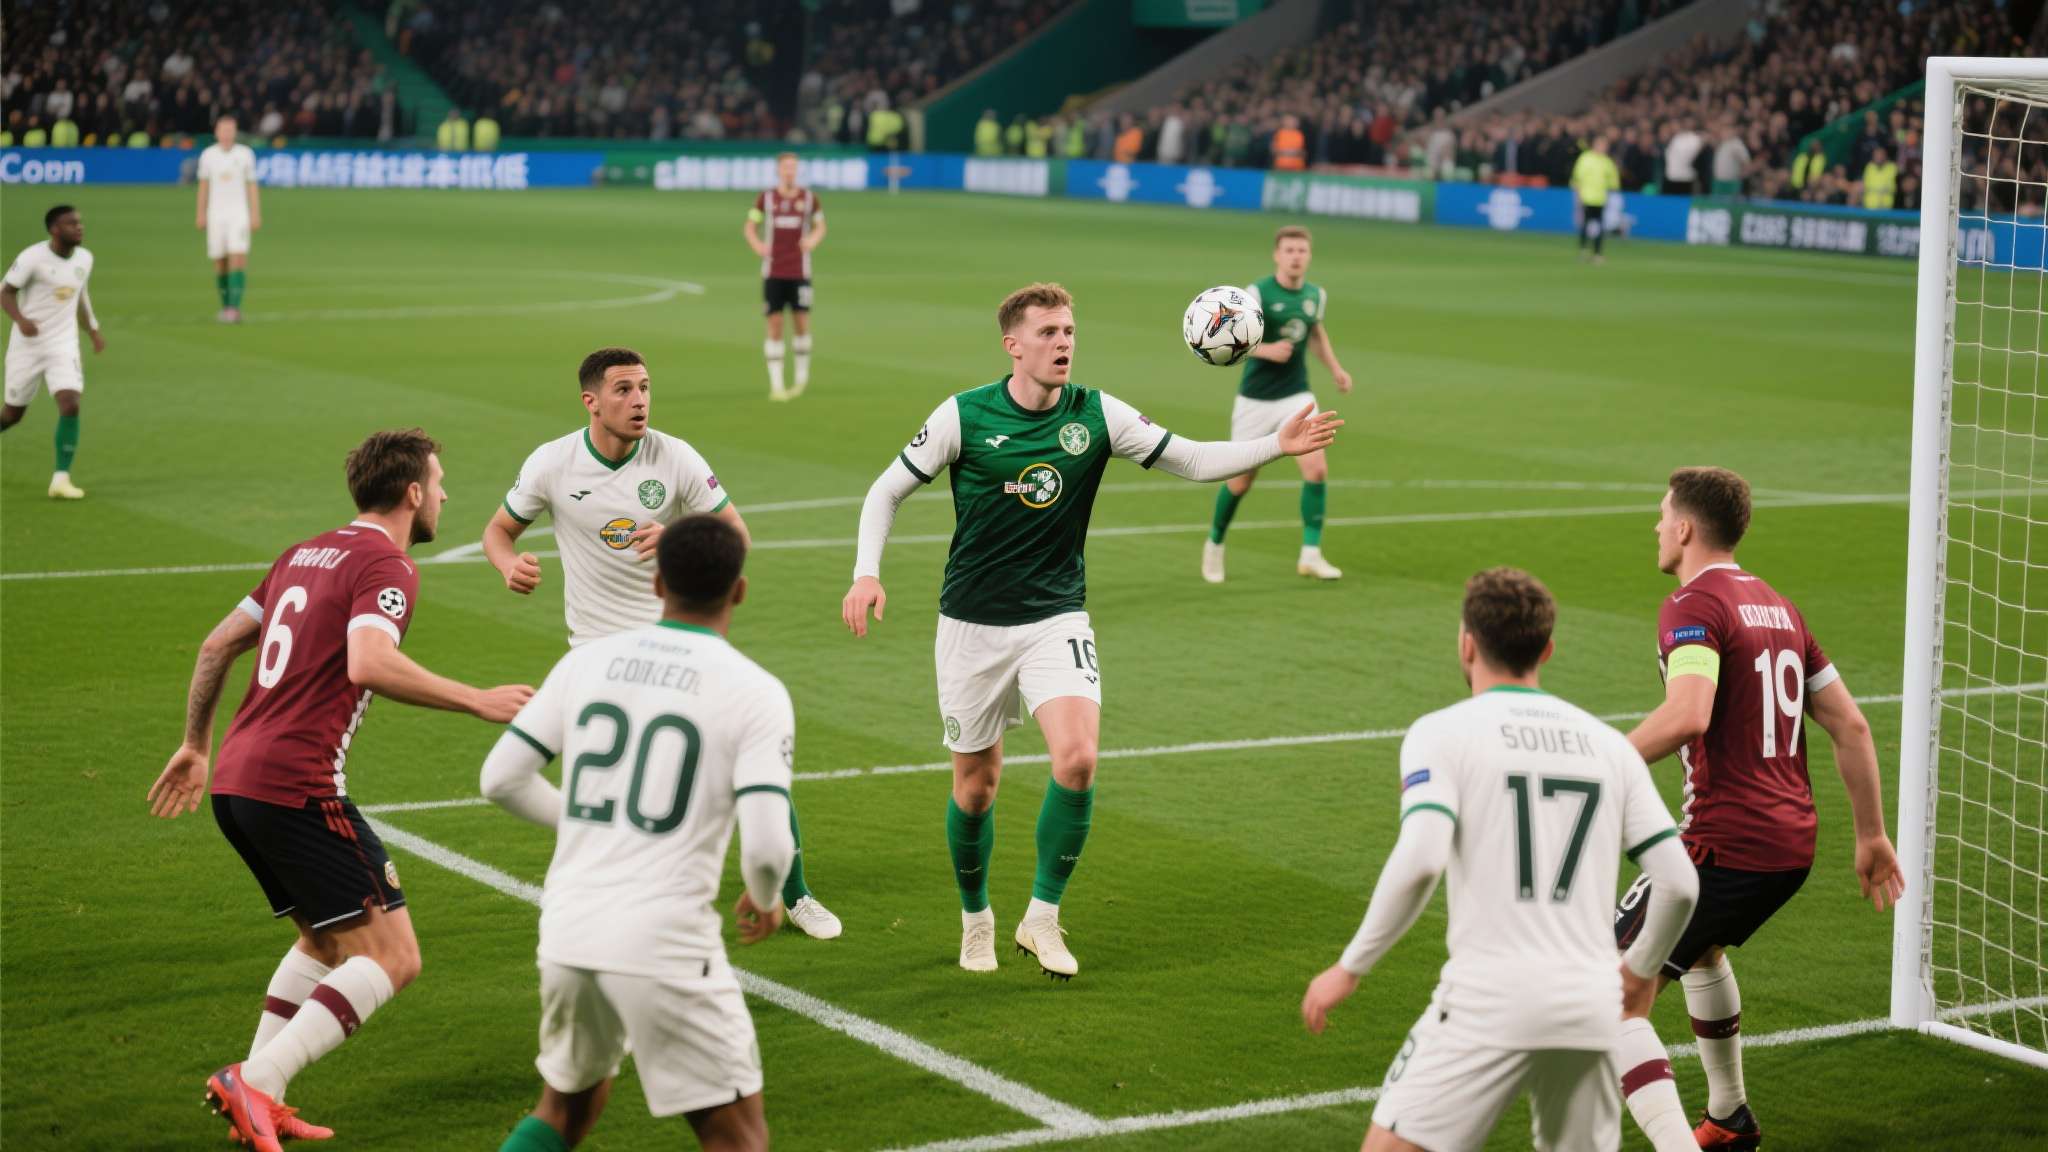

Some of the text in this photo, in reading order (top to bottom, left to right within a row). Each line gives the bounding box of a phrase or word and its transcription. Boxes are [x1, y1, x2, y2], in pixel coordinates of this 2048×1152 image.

[258, 585, 308, 689] 6
[1754, 648, 1805, 758] 19
[567, 701, 703, 834] 20
[1506, 774, 1602, 901] 17
